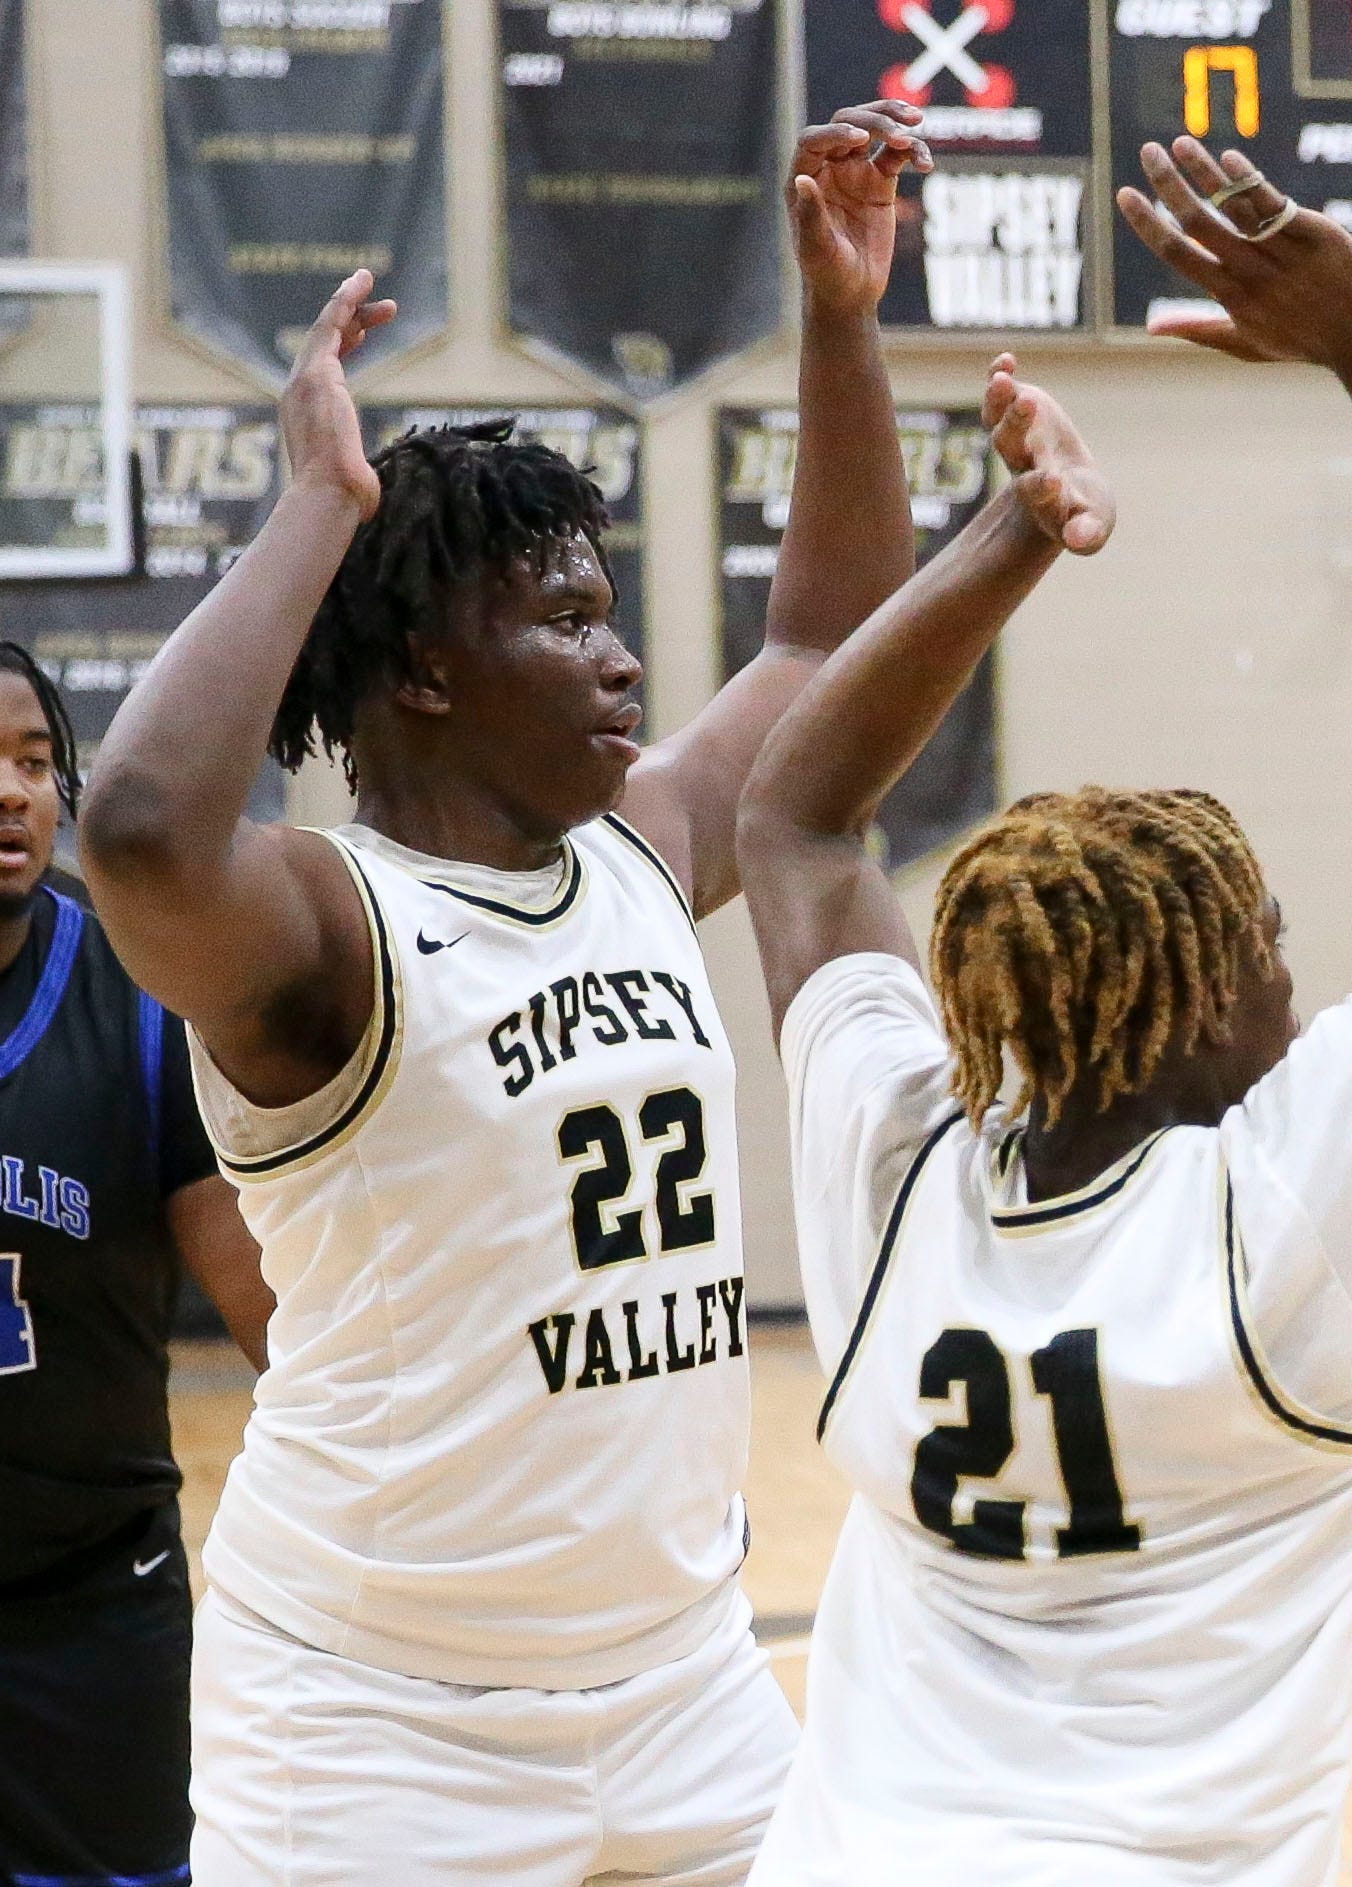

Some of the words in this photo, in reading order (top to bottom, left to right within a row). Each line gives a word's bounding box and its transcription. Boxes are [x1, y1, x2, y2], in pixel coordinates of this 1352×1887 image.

[1115, 0, 1272, 38] GUEST
[1183, 45, 1260, 138] 17
[487, 969, 713, 1099] SIPSEY
[0, 1154, 91, 1241] LIS
[554, 1083, 717, 1279] 22
[527, 1276, 745, 1396] VALLEY
[909, 1326, 1143, 1560] 21
